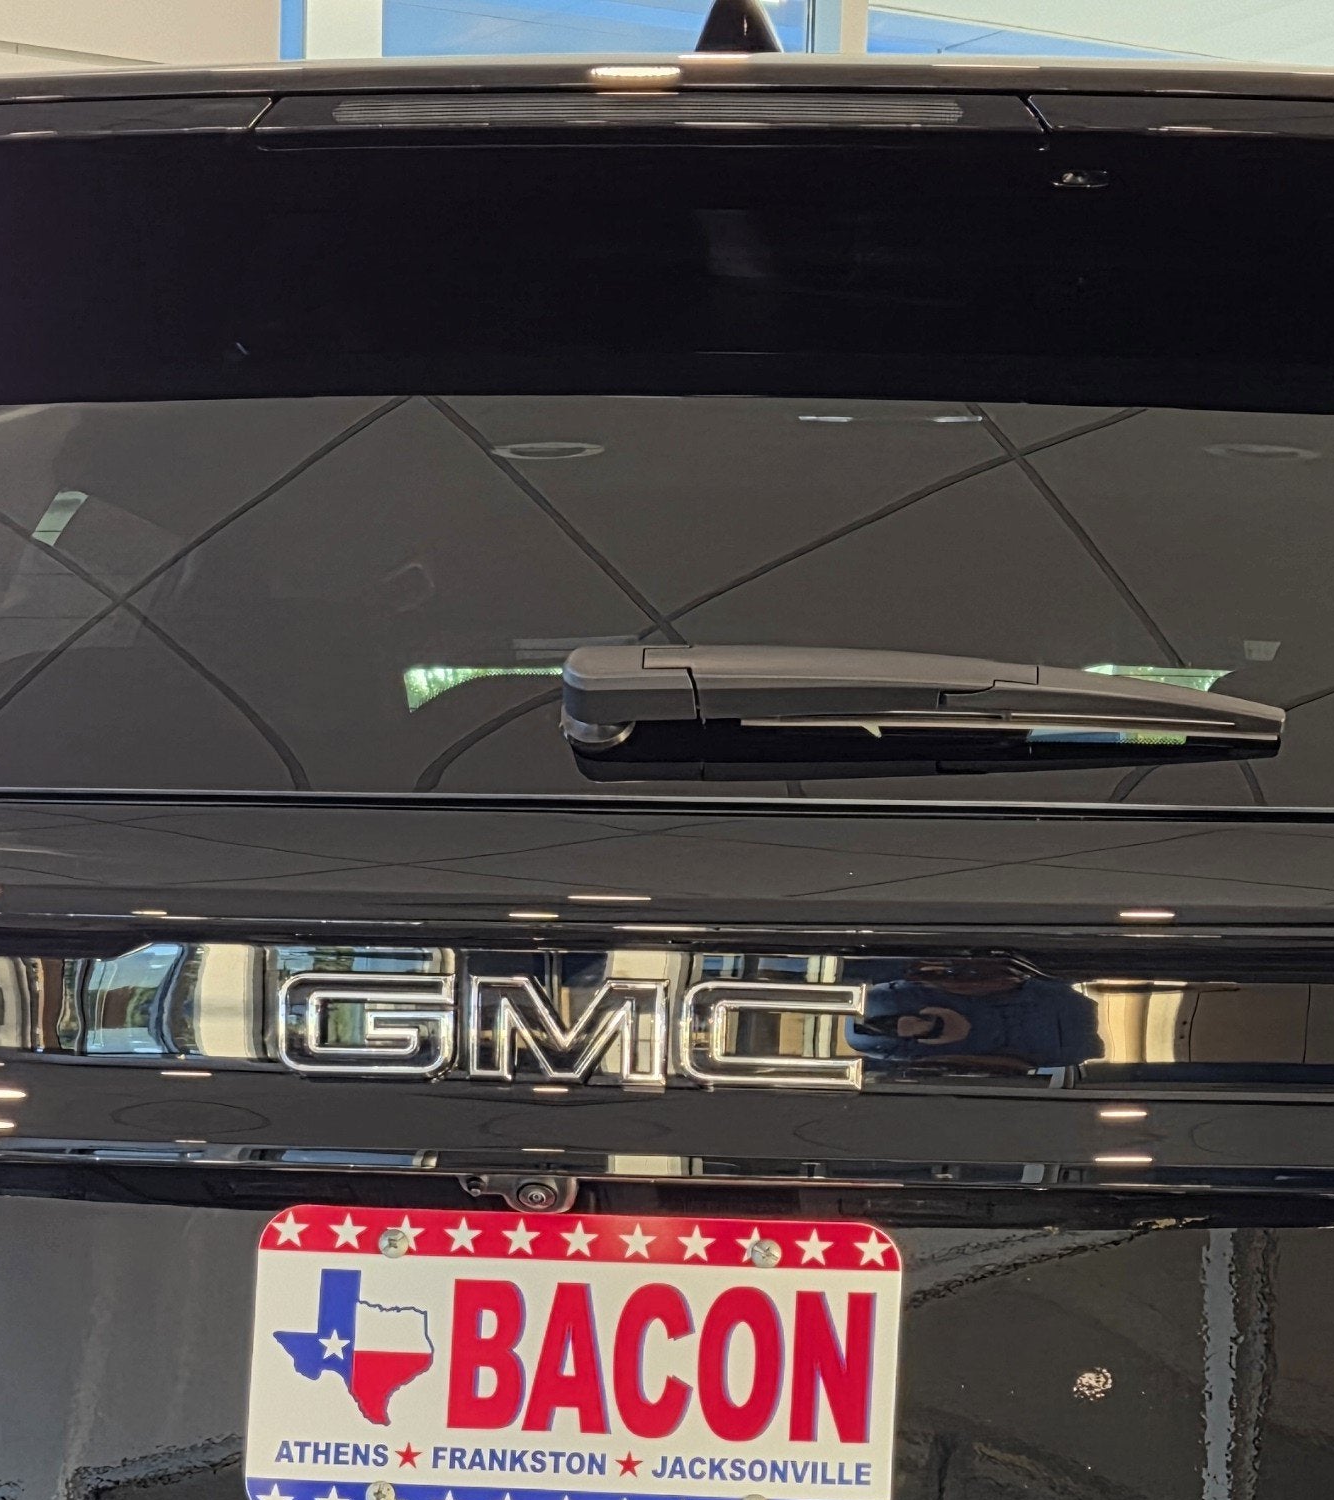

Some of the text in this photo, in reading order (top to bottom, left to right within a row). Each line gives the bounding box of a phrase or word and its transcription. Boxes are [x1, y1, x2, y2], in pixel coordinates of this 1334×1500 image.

[280, 971, 866, 1091] GMC
[447, 1278, 877, 1444] BACON
[275, 1440, 872, 1486] ATHENS FRANKSTON JACKSONVILLE
